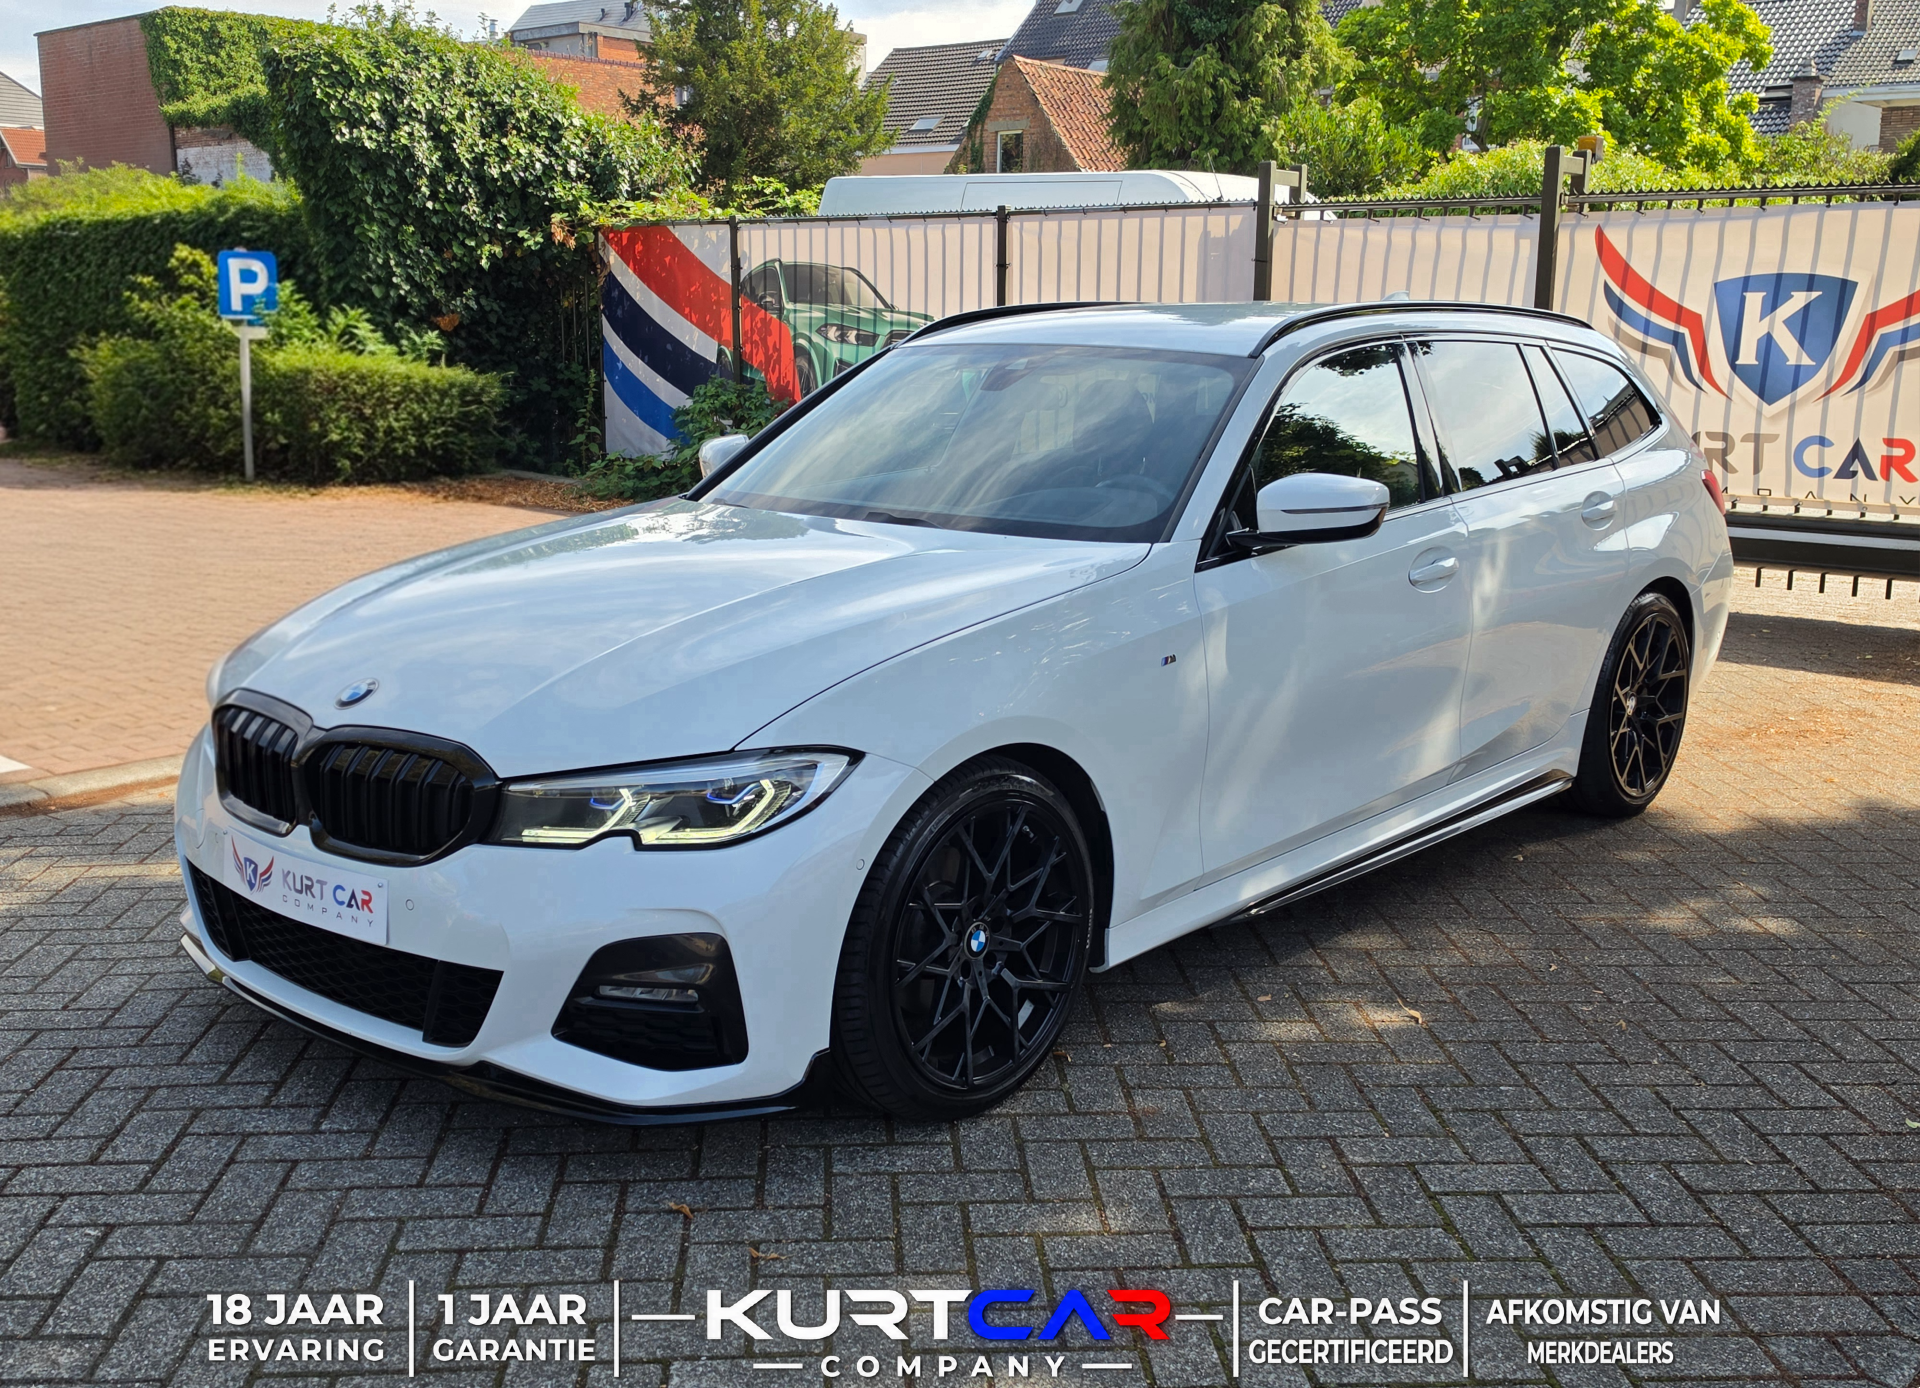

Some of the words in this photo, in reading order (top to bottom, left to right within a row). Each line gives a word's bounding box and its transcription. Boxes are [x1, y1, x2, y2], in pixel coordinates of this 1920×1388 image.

[227, 257, 269, 312] P
[1734, 290, 1823, 366] K
[1691, 430, 1780, 475] RT
[1793, 434, 1920, 484] CAR
[281, 867, 328, 901] KURT
[332, 884, 374, 914] CAR
[282, 894, 374, 927] COMPANY
